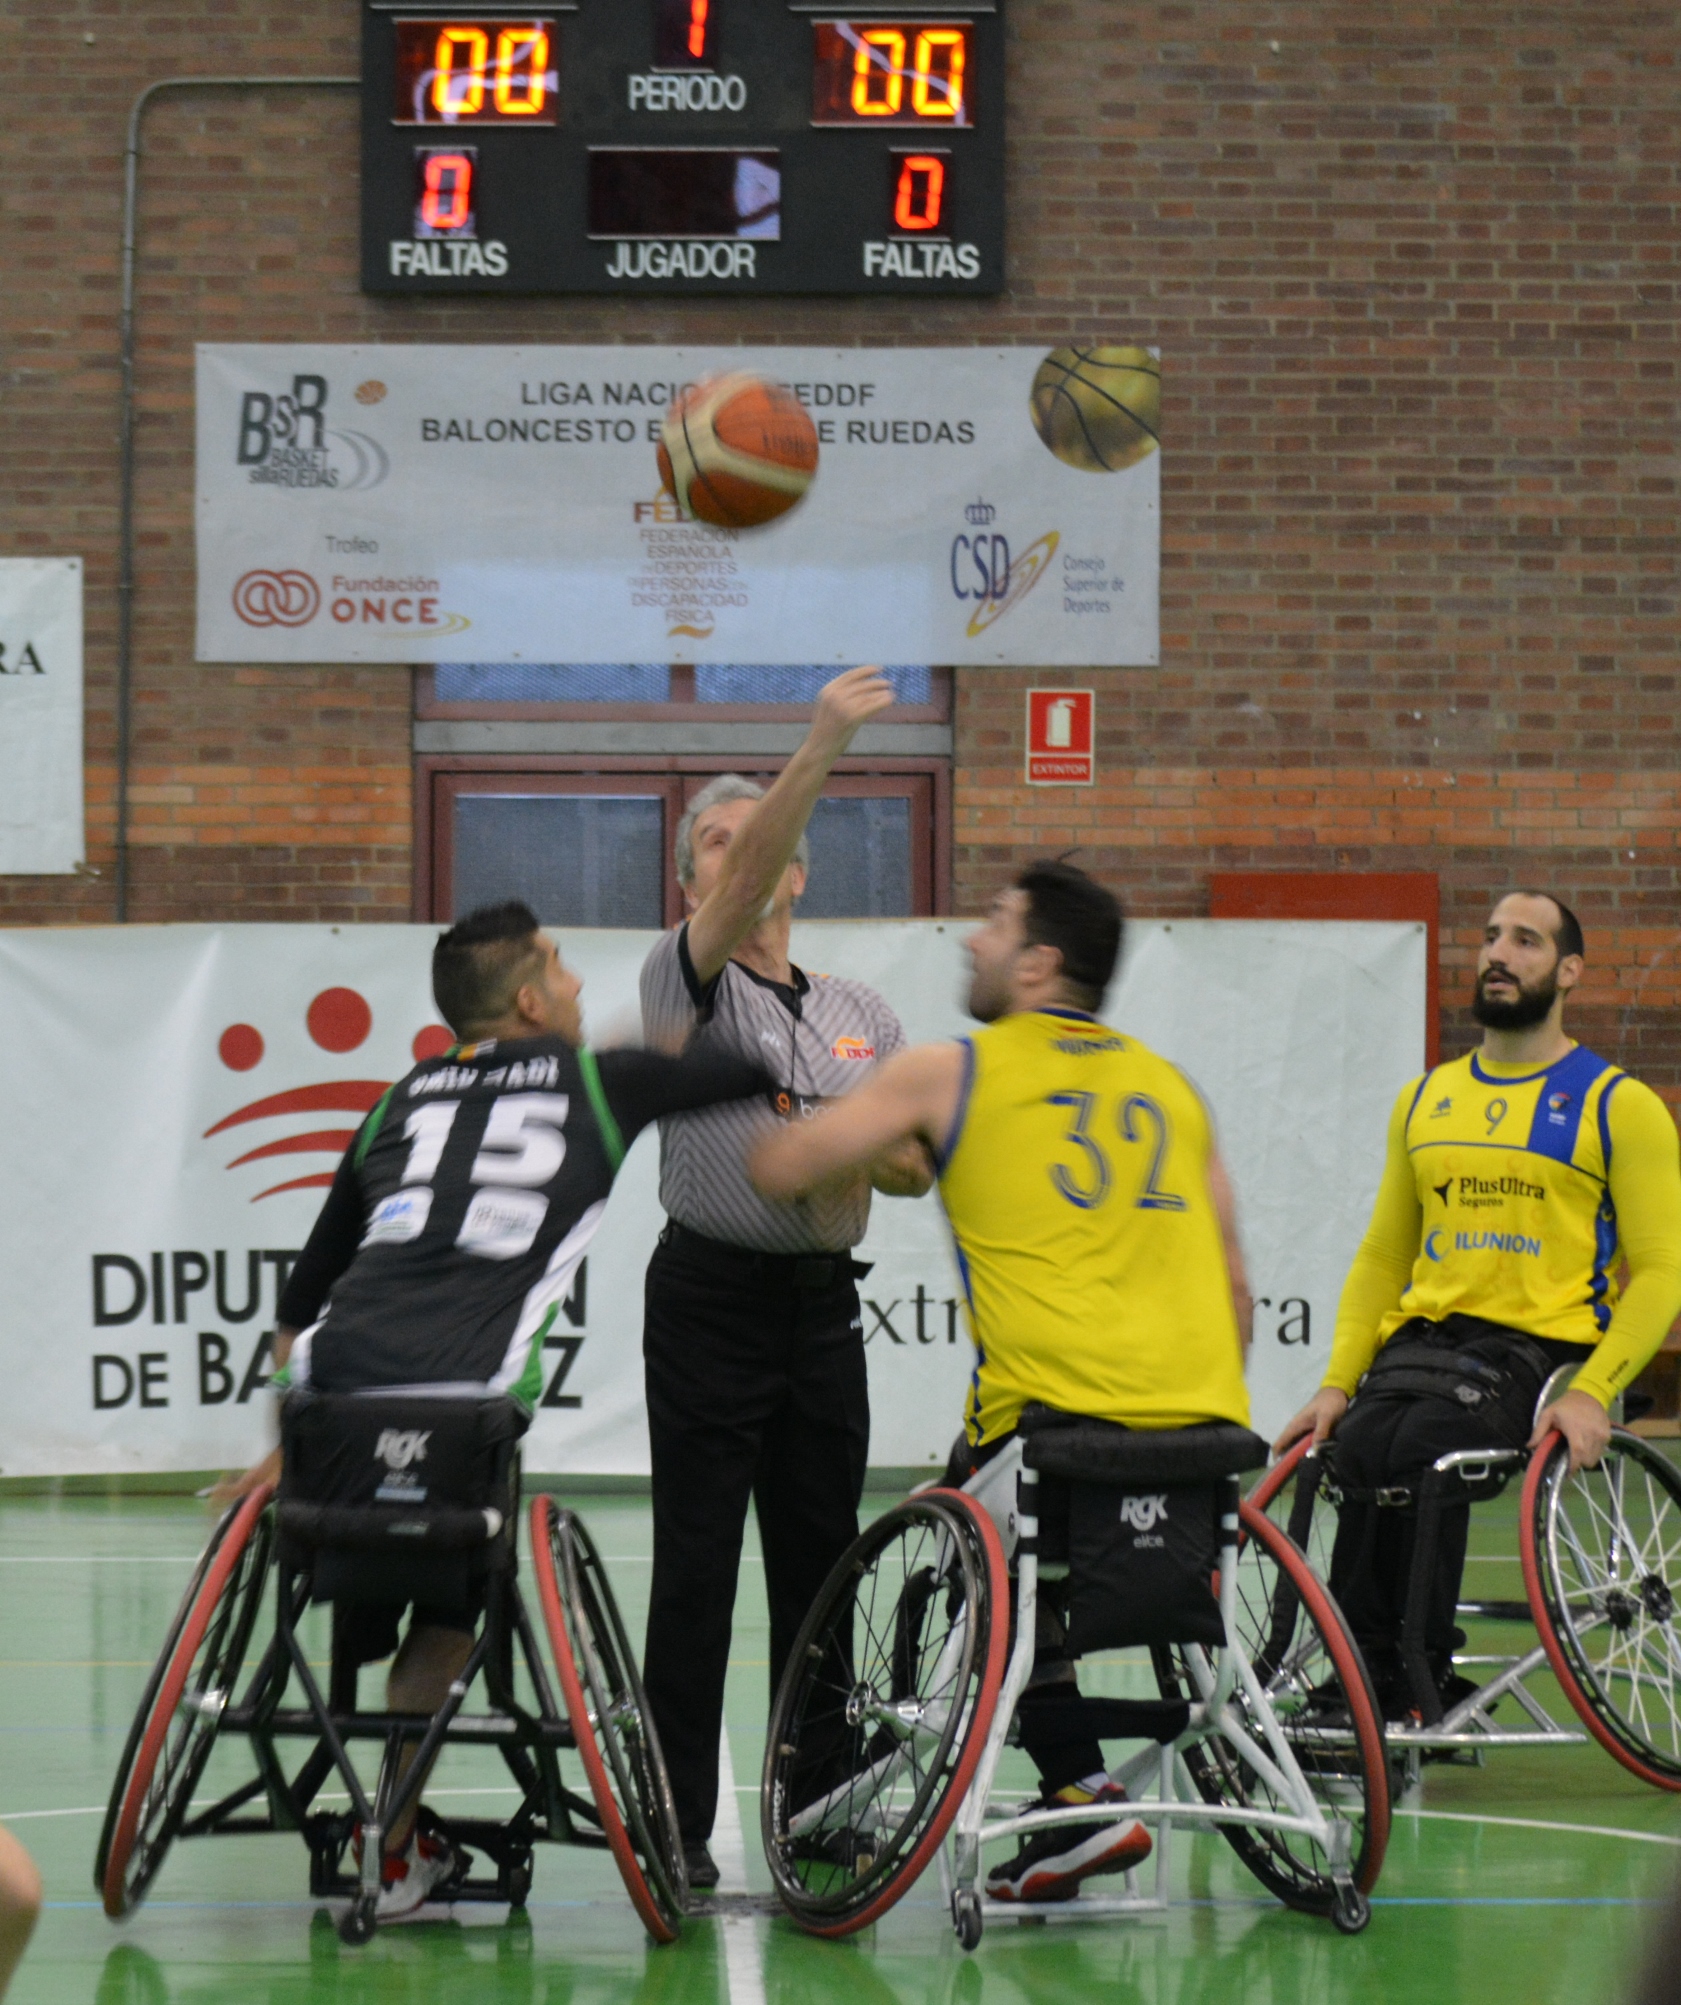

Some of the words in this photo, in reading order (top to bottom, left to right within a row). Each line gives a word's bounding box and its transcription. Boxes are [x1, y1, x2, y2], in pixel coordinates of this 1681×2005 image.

[432, 28, 549, 114] 00
[852, 30, 965, 116] 00
[628, 75, 748, 112] PERIODO
[421, 155, 471, 228] 0
[894, 156, 944, 229] 0
[390, 241, 508, 277] FALTAS
[606, 244, 756, 279] JUGADOR
[863, 241, 981, 279] FALTAS
[520, 381, 593, 406] LIGA
[421, 418, 637, 442] BALONCESTO
[846, 420, 977, 444] RUEDAS
[325, 535, 379, 554] Trofeo
[951, 533, 1010, 600] CSD
[1063, 555, 1105, 575] Consejo
[332, 575, 441, 592] Fundación
[1063, 576, 1108, 597] Superior
[1112, 577, 1125, 592] de
[331, 598, 439, 624] ONCE
[1063, 597, 1111, 616] Deportes
[1032, 763, 1088, 775] EXTINTOR
[1485, 1096, 1508, 1136] 9
[401, 1091, 569, 1188] 15
[1047, 1090, 1187, 1211] 32
[1459, 1197, 1504, 1209] Seguros
[1455, 1231, 1541, 1258] ILUNION
[92, 1353, 169, 1410] DE
